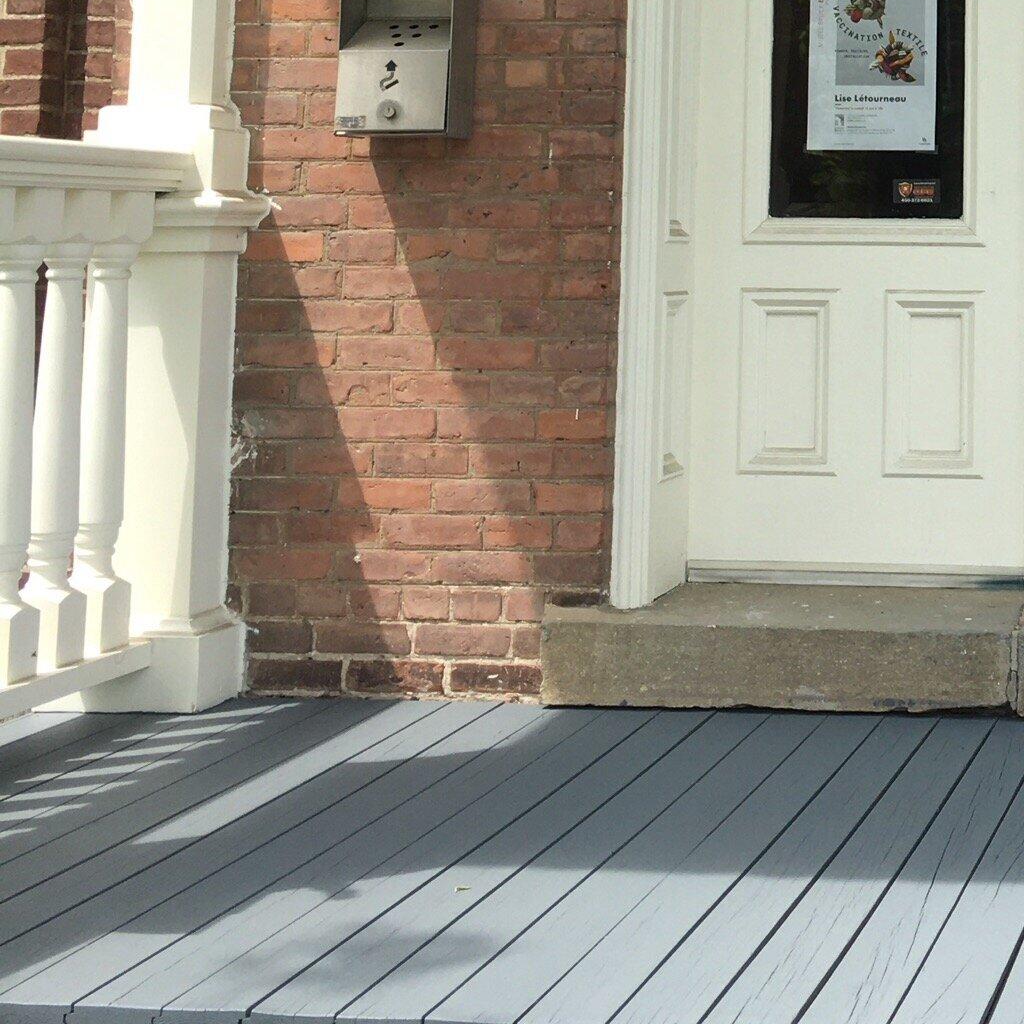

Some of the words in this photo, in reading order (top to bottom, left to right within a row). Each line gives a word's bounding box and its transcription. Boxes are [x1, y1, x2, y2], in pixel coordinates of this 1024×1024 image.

[833, 5, 884, 43] VACCINATION
[895, 28, 929, 57] TEXTILE
[834, 93, 852, 103] Lise
[854, 93, 907, 103] Létourneau
